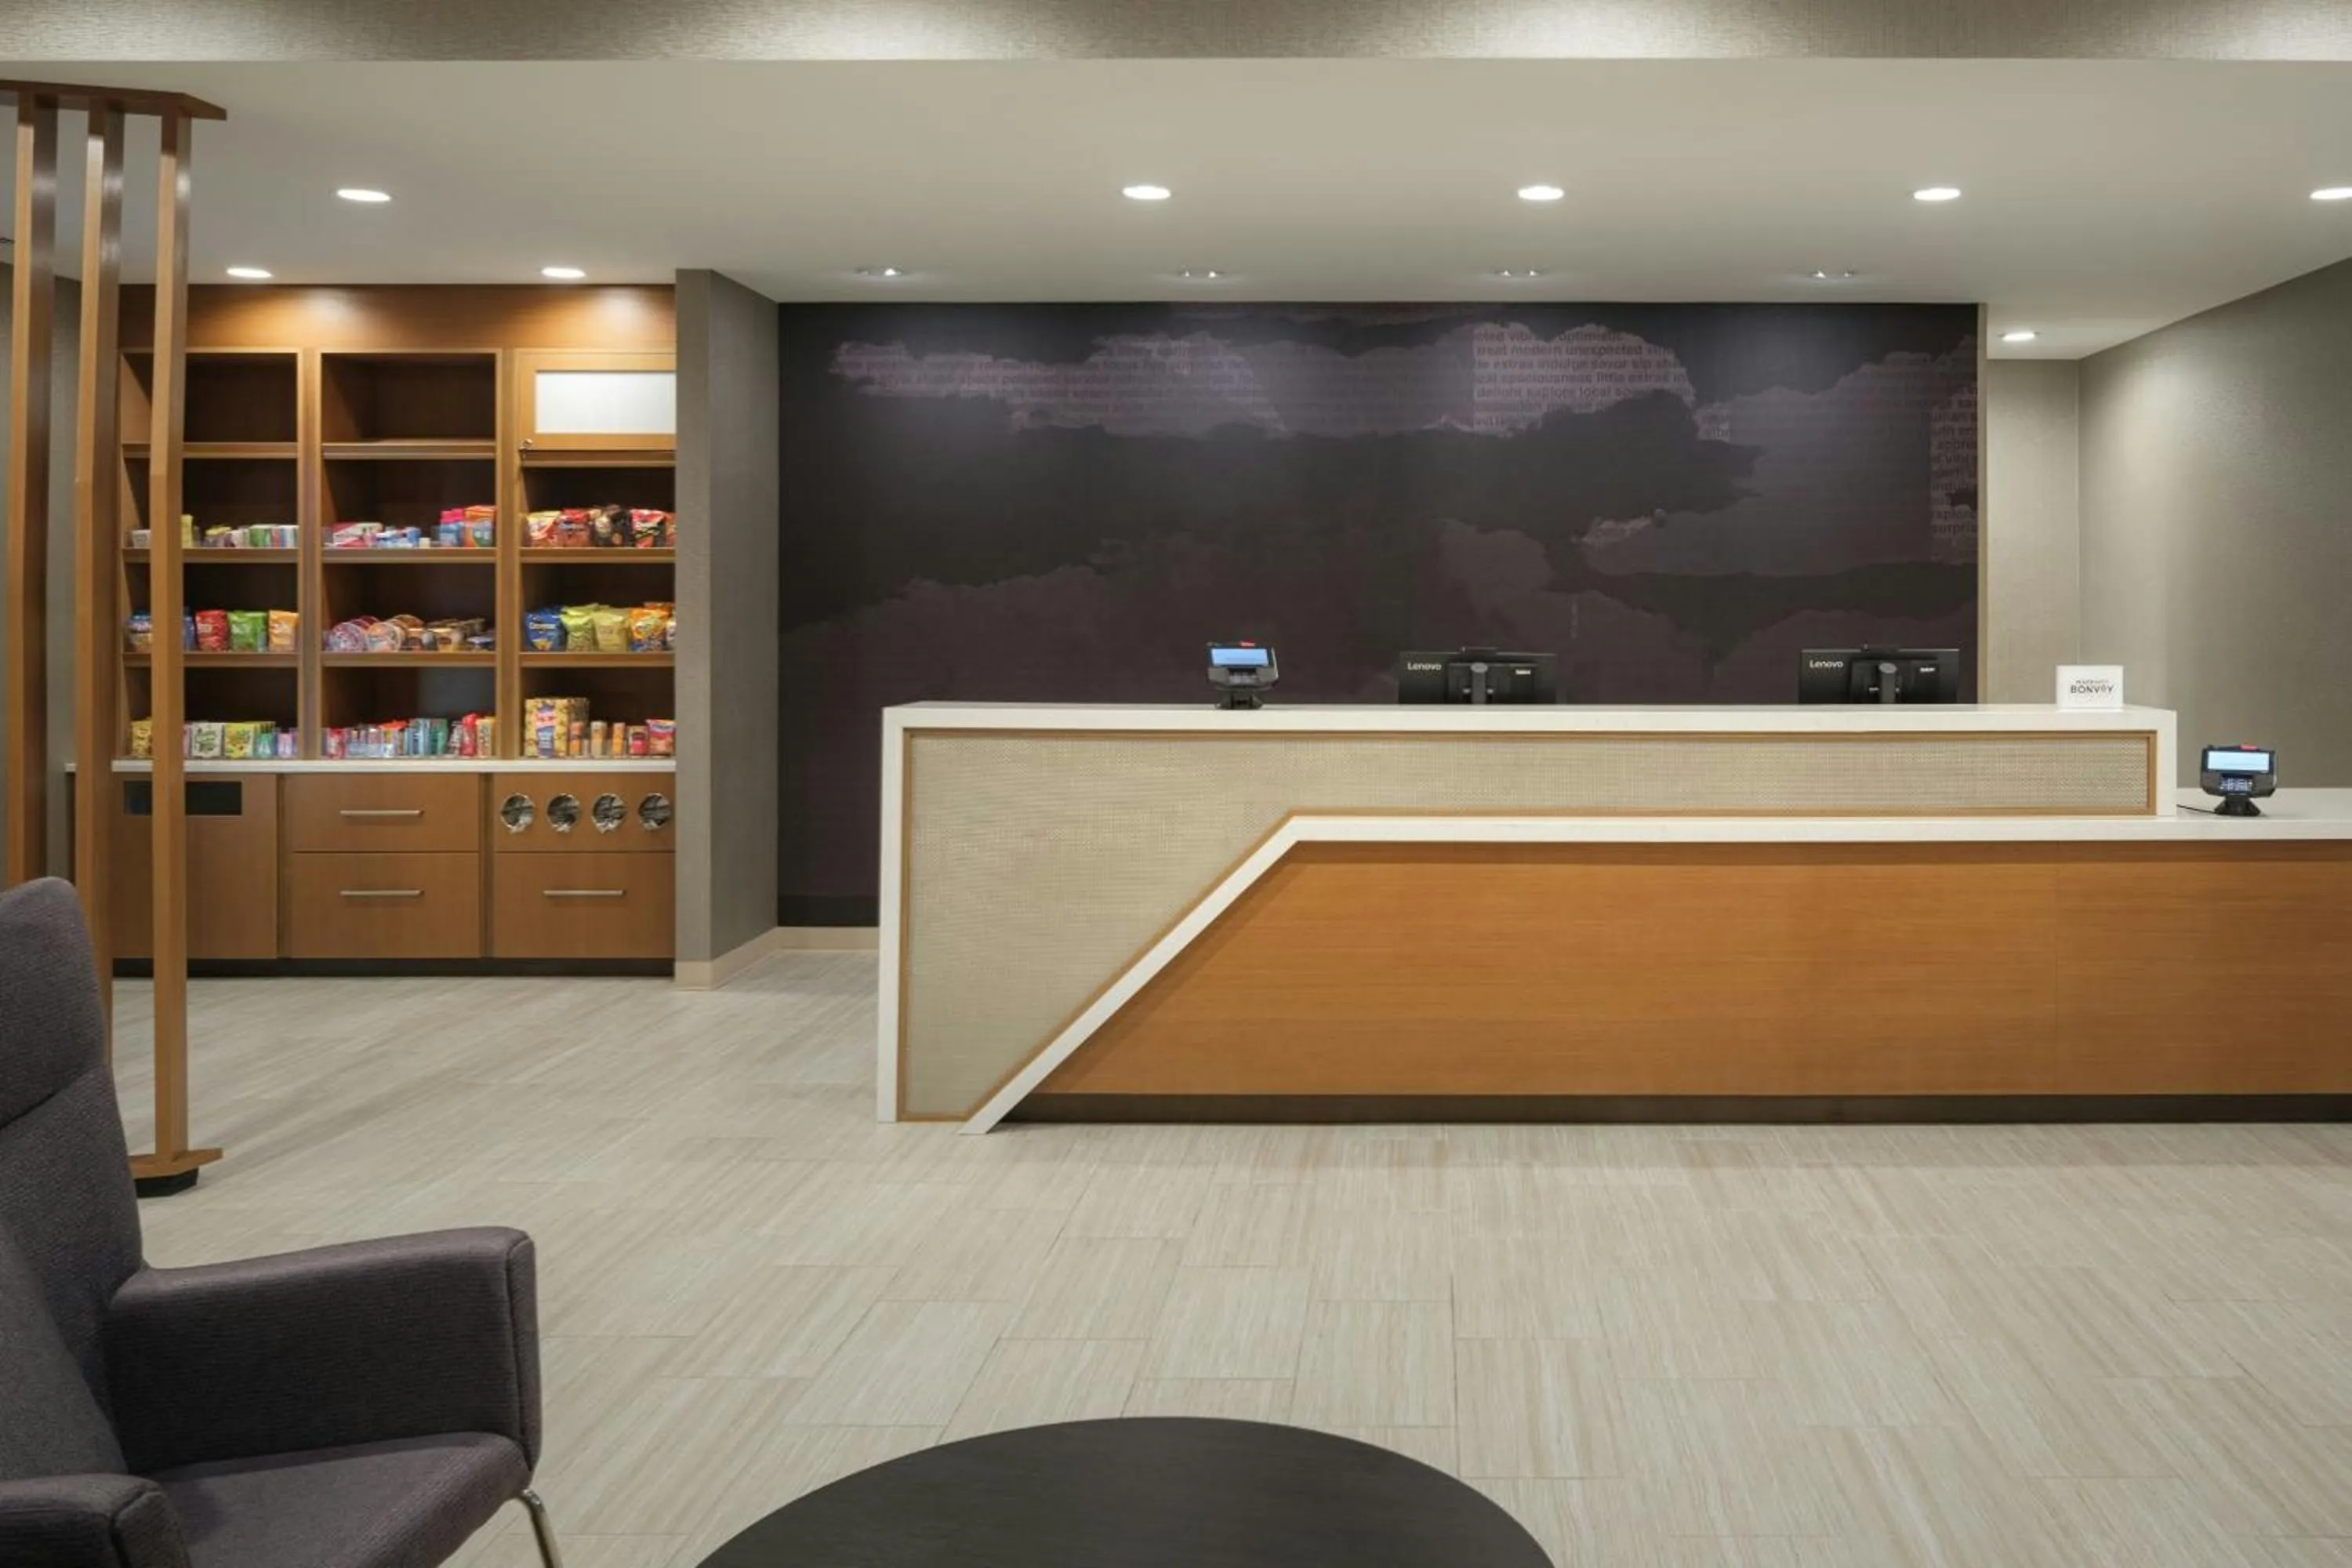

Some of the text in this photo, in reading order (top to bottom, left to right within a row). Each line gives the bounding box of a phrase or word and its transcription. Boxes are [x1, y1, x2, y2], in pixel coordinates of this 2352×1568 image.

[1407, 662, 1442, 671] Lenovo
[1809, 659, 1843, 669] Lenovo
[2071, 684, 2114, 694] BONVOY
